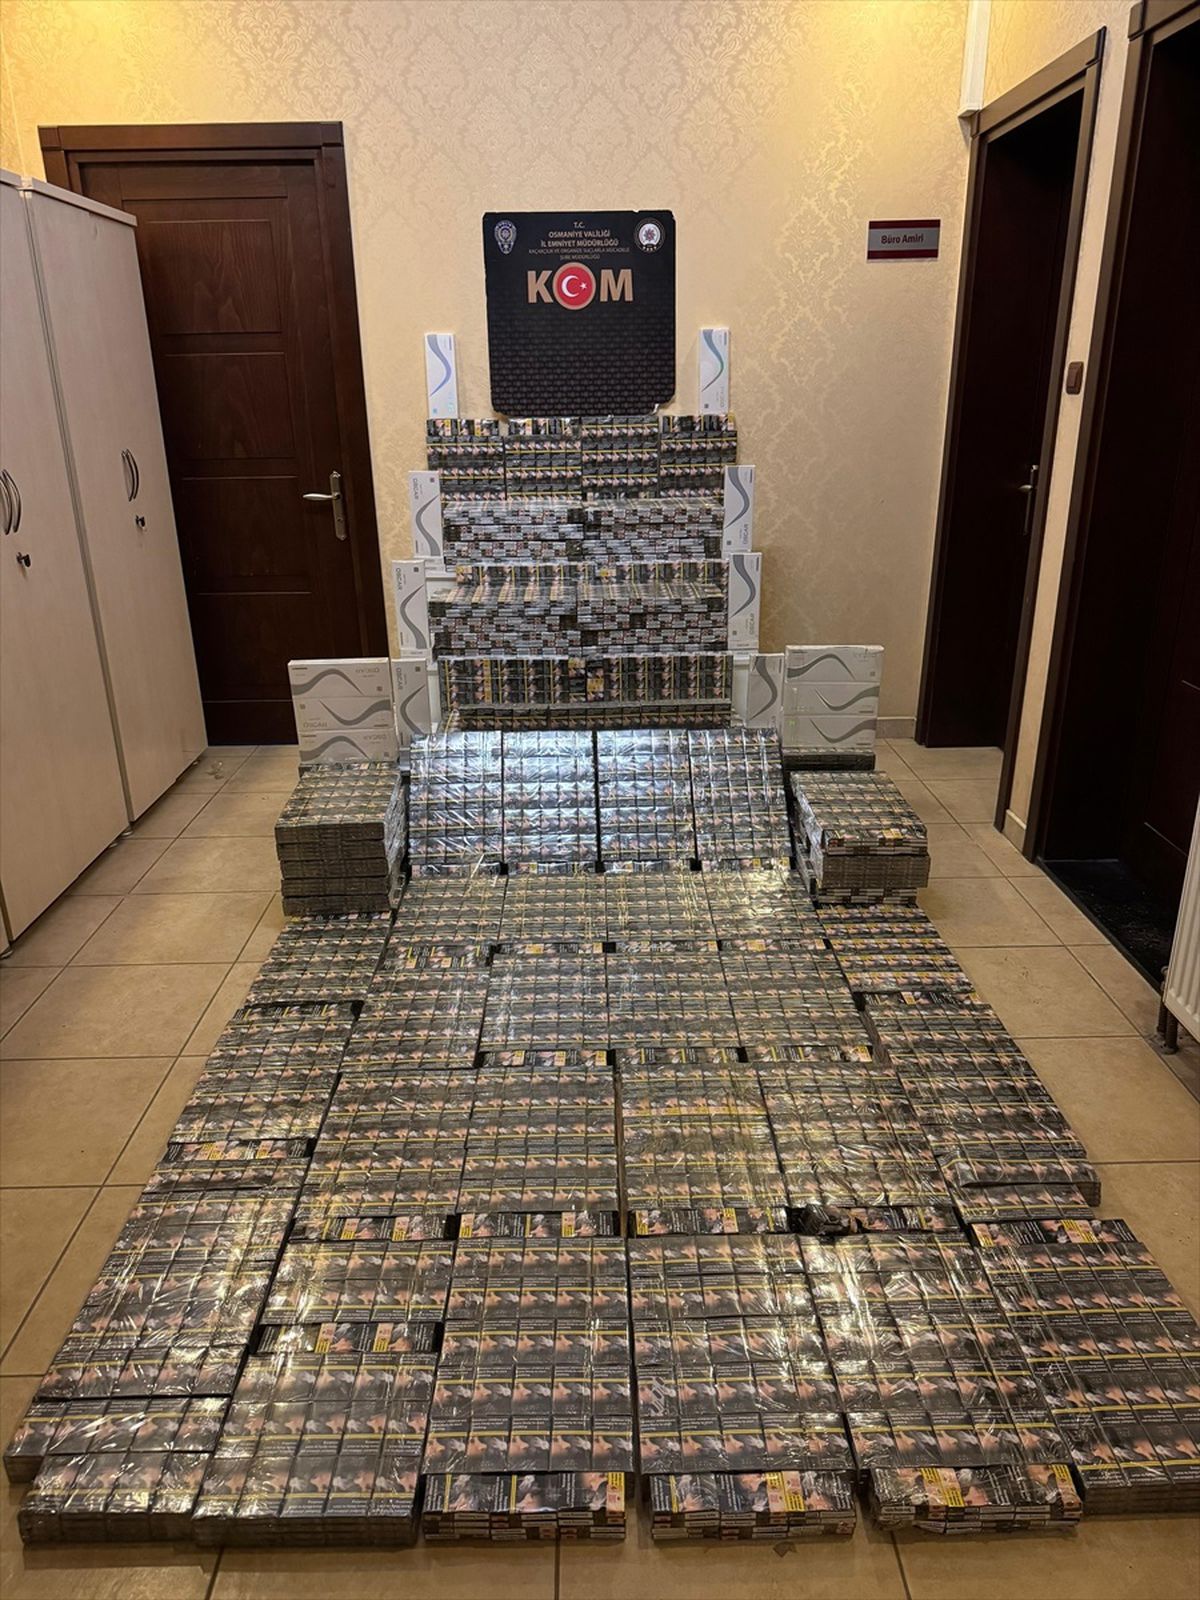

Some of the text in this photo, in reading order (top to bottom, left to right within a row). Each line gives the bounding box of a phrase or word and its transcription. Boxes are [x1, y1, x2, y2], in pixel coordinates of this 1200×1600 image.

[548, 229, 611, 238] OSMANİYE VALİLİĞİ
[548, 239, 576, 247] EMNİYET
[577, 238, 619, 247] MÜDÜRLÜĞÜ
[881, 233, 924, 244] Büro Amiri
